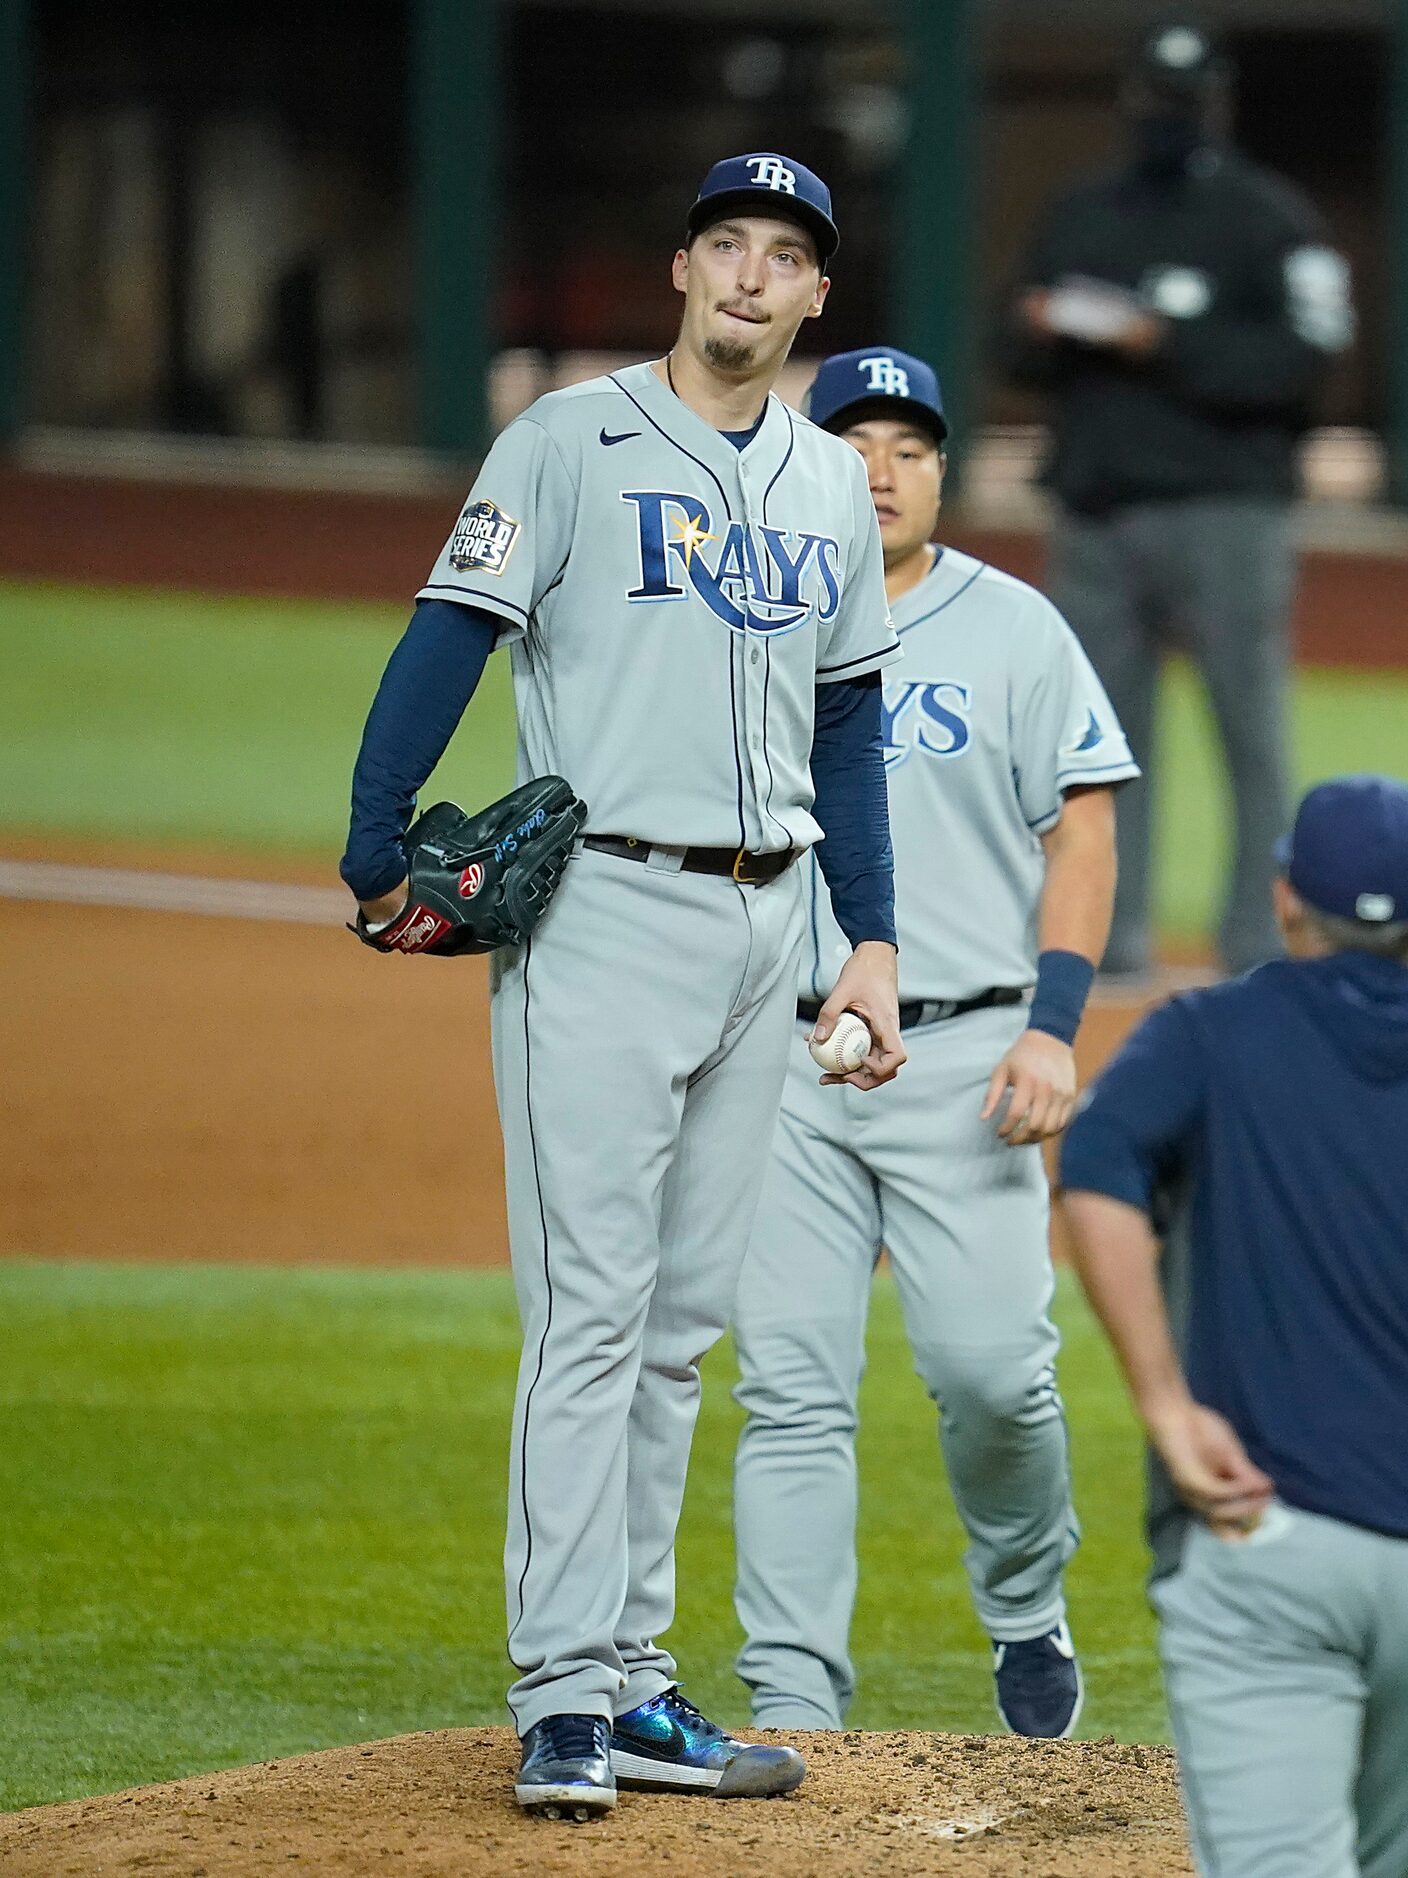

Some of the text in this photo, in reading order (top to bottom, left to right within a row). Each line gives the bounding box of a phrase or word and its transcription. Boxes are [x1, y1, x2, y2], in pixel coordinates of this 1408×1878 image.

[745, 157, 796, 195] TB
[857, 356, 910, 397] TB
[456, 516, 513, 546] WORLD
[451, 535, 506, 566] SERIES
